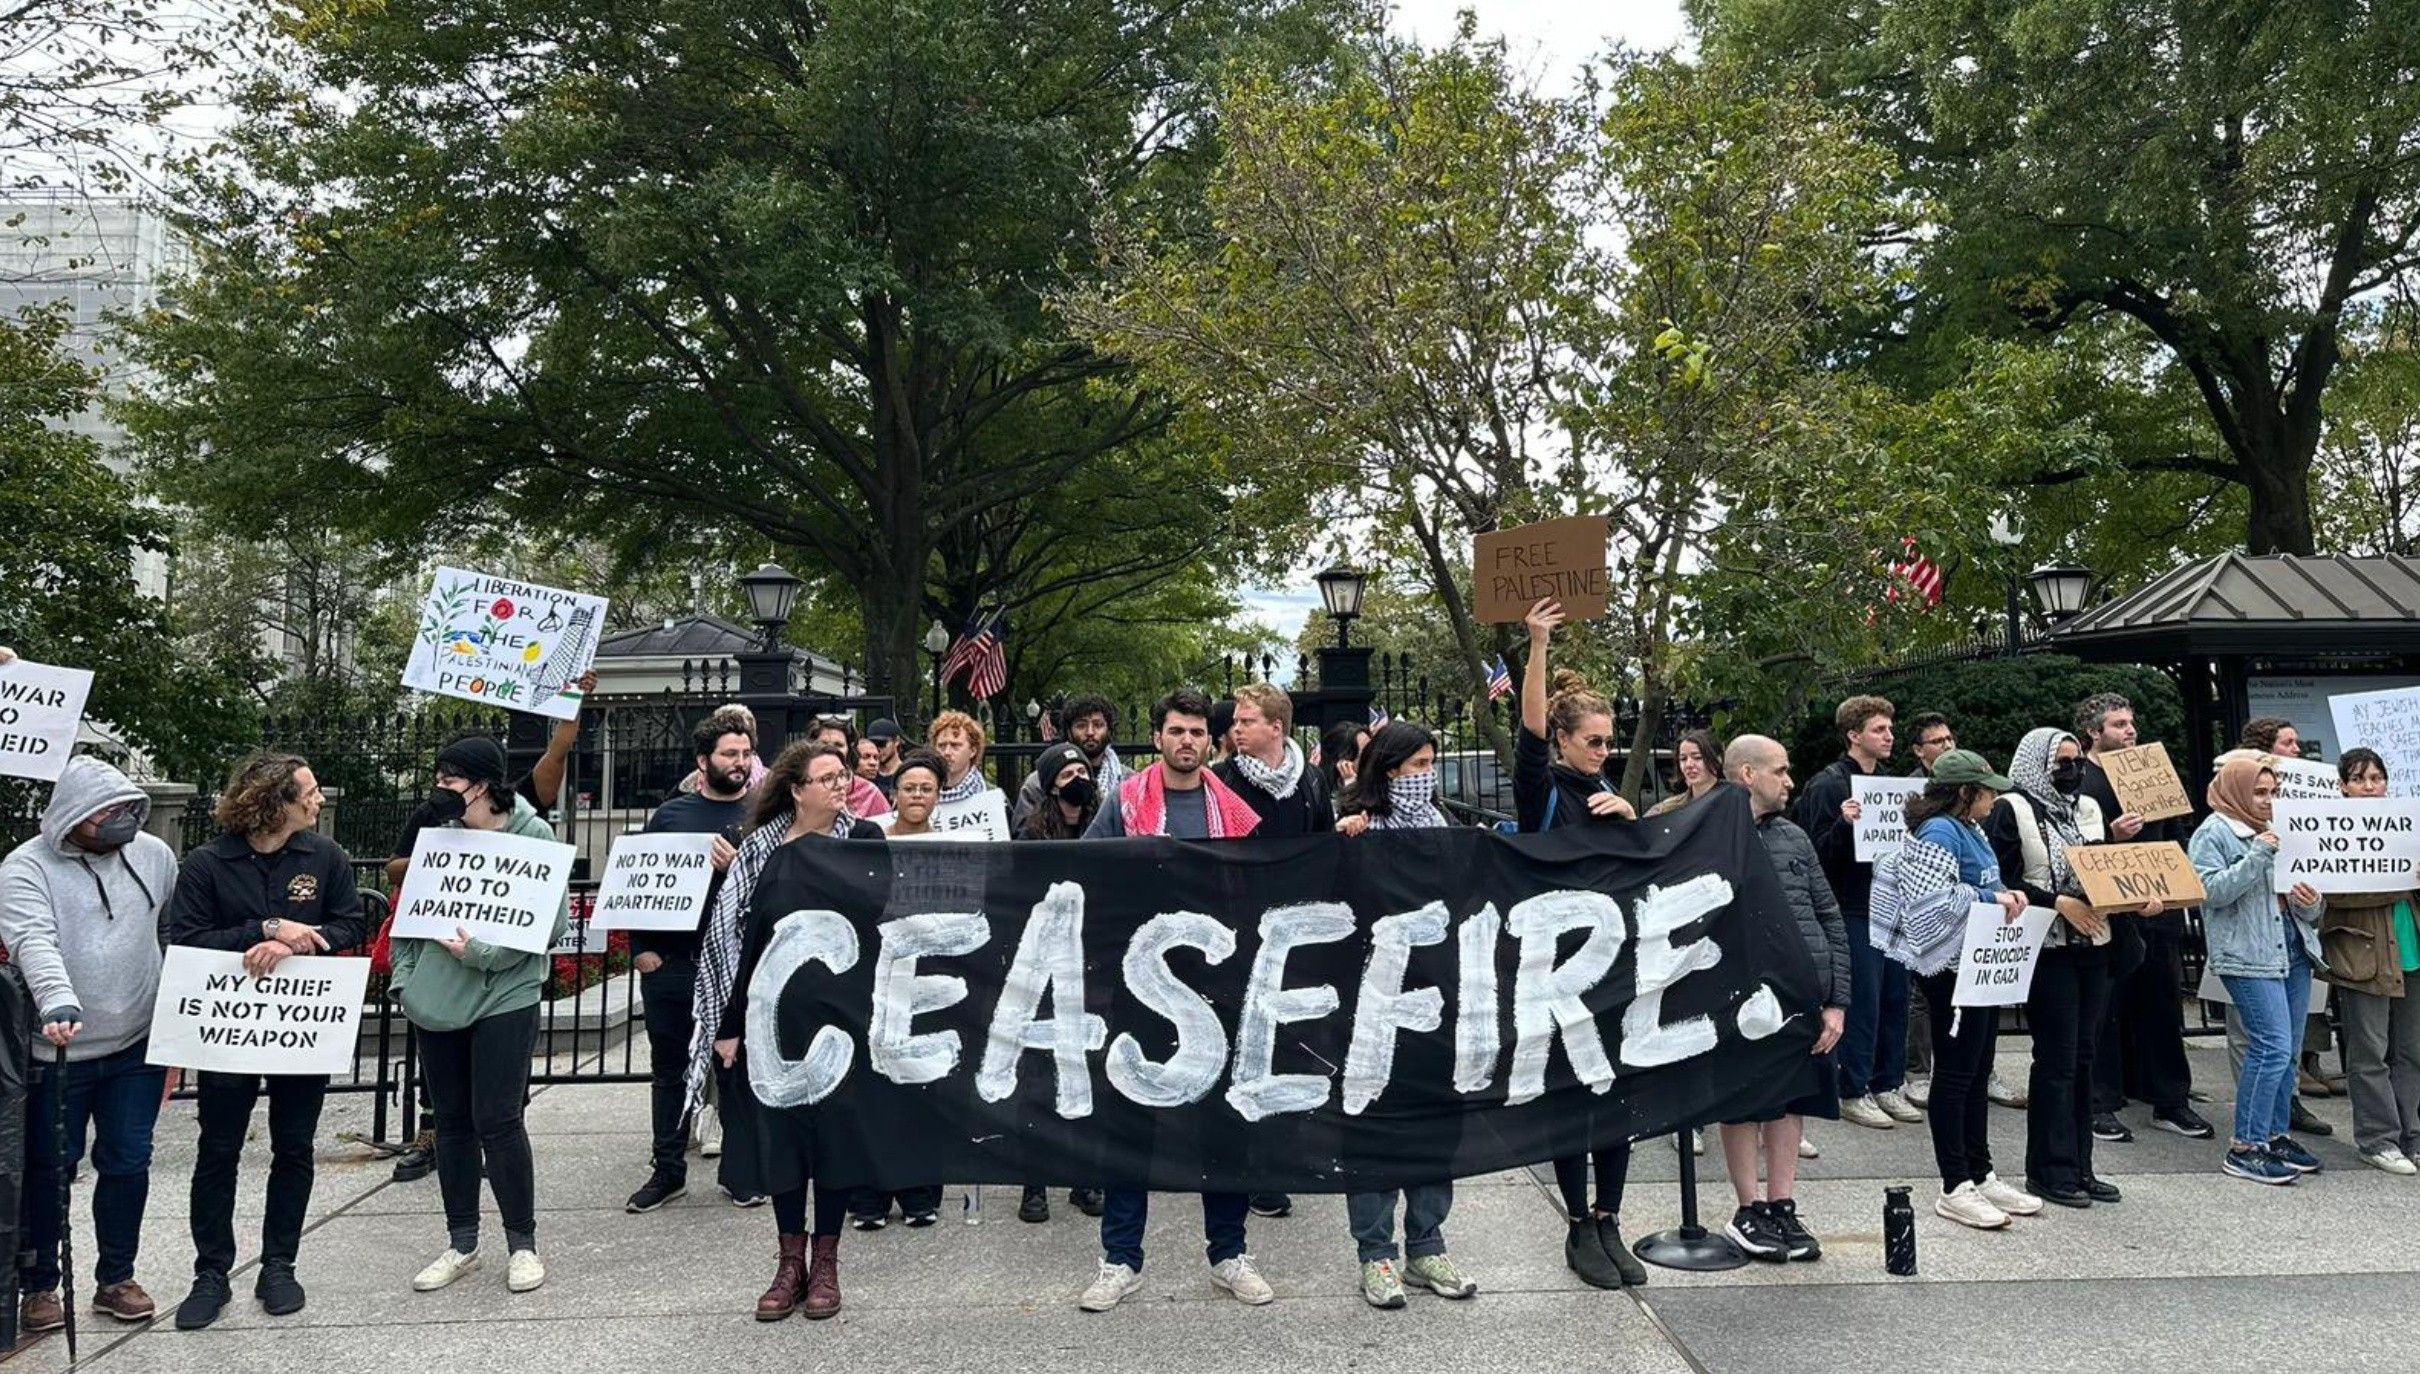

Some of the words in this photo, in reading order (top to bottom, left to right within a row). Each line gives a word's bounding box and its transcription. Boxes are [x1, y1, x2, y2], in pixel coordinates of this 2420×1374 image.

[1495, 541, 1558, 569] FREE
[473, 577, 577, 607] LIBERATION
[1493, 567, 1604, 603] PALESTINE
[479, 629, 526, 649] THE
[2, 680, 66, 708] WAR
[438, 671, 524, 703] PEOPLE
[0, 733, 48, 755] EID
[2115, 747, 2160, 776] JEWS
[2116, 768, 2174, 799] Against
[1863, 791, 1883, 805] NO
[1887, 791, 1904, 805] TO
[948, 810, 989, 831] SAY:
[1879, 810, 1899, 823] NO
[2289, 816, 2319, 832] NO
[2326, 816, 2354, 832] TO
[2362, 816, 2412, 832] WAR
[1862, 828, 1904, 842] APART
[2318, 837, 2349, 852] NO
[2356, 837, 2385, 851] TO
[422, 851, 451, 868] NO
[458, 852, 486, 871] TO
[495, 856, 552, 882] WAR
[616, 853, 636, 869] NO
[640, 853, 659, 868] TO
[665, 853, 705, 869] WAR
[2078, 846, 2179, 872] CEASEFIRE
[2290, 858, 2412, 873] APARTHEID
[440, 875, 472, 894] NO
[480, 878, 510, 898] TO
[627, 873, 650, 888] NO
[655, 873, 677, 888] TO
[2112, 871, 2171, 900] NOW
[408, 898, 536, 928] APARTHEID
[603, 894, 693, 911] APARTHEID
[1995, 926, 2024, 943] STOP
[1973, 946, 2031, 964] GENOCIDE
[206, 974, 247, 992] MY
[255, 976, 332, 997] GRIEF
[1975, 969, 1992, 986] IN
[1993, 967, 2020, 985] GAZA
[745, 873, 1784, 1122] CEASEFIRE.
[178, 997, 203, 1017] IS
[211, 1001, 268, 1020] NOT
[277, 1004, 347, 1023] YOUR
[199, 1026, 318, 1049] WEAPON
